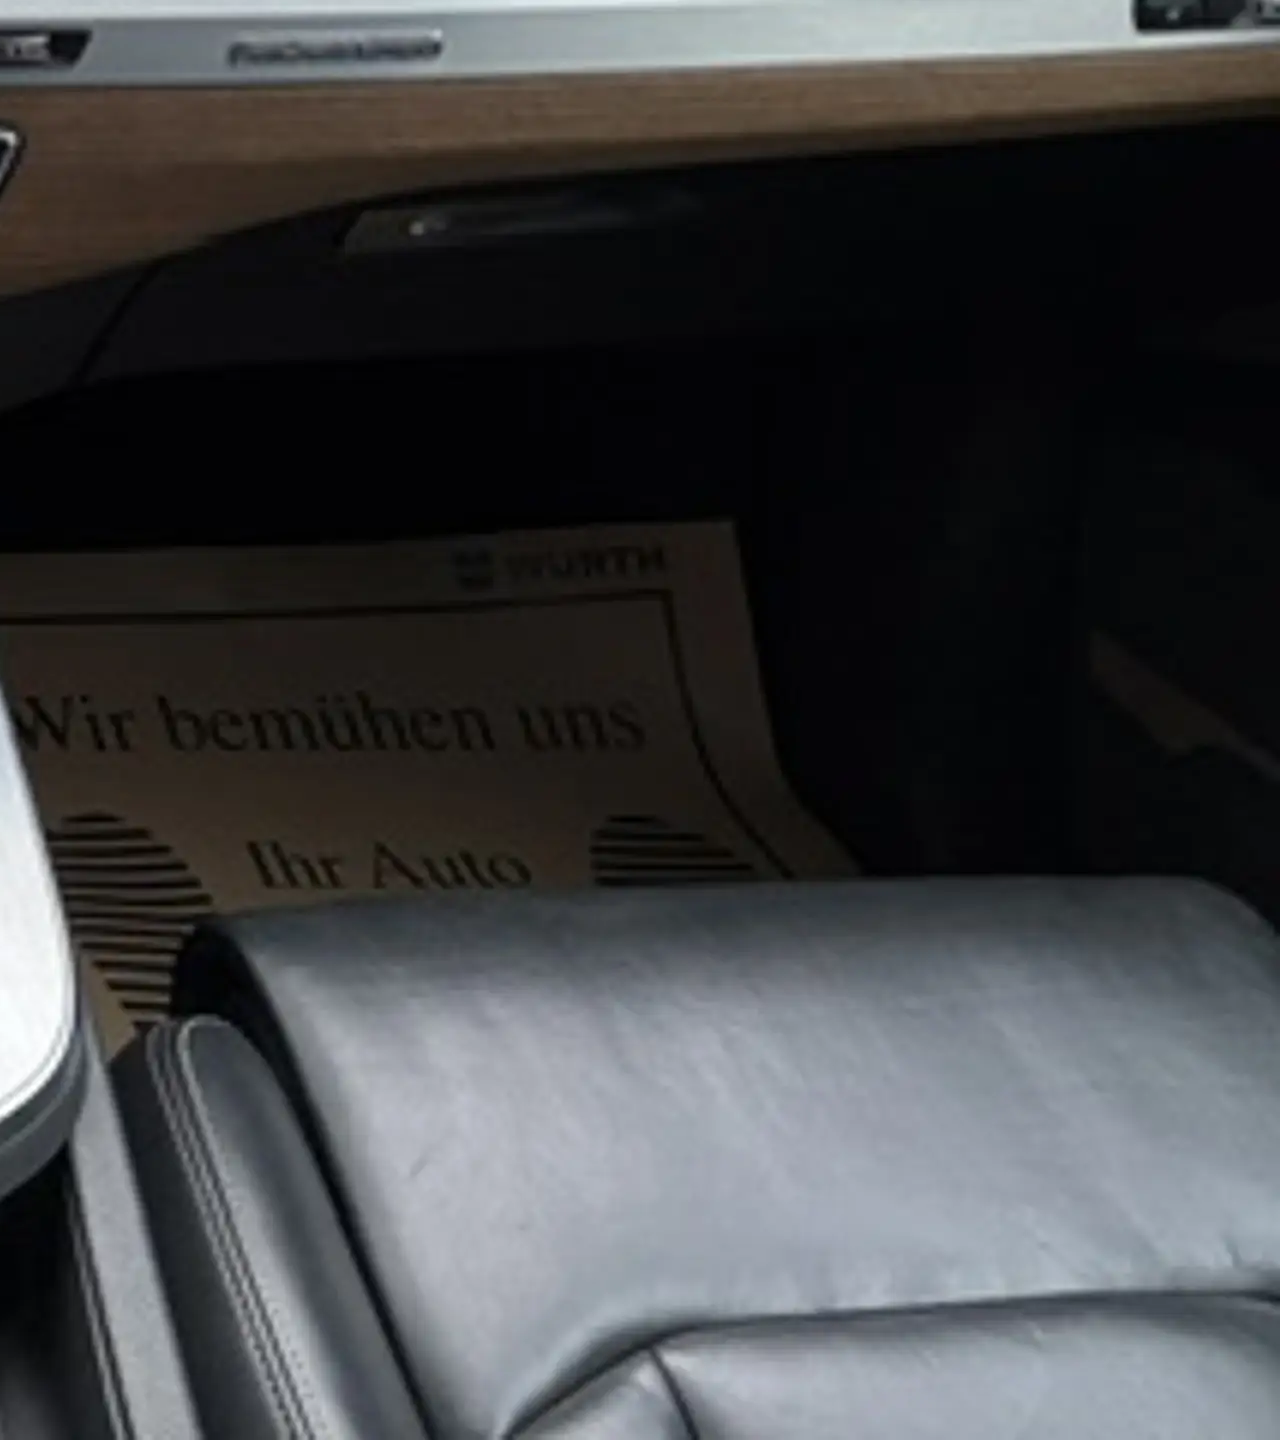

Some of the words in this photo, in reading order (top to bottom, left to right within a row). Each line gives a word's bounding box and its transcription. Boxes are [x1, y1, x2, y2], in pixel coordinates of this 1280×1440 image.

[15, 693, 137, 752] Wir
[156, 690, 497, 755] bemühen
[517, 697, 645, 749] uns
[245, 839, 345, 891] Ihr
[372, 842, 532, 891] Auto
